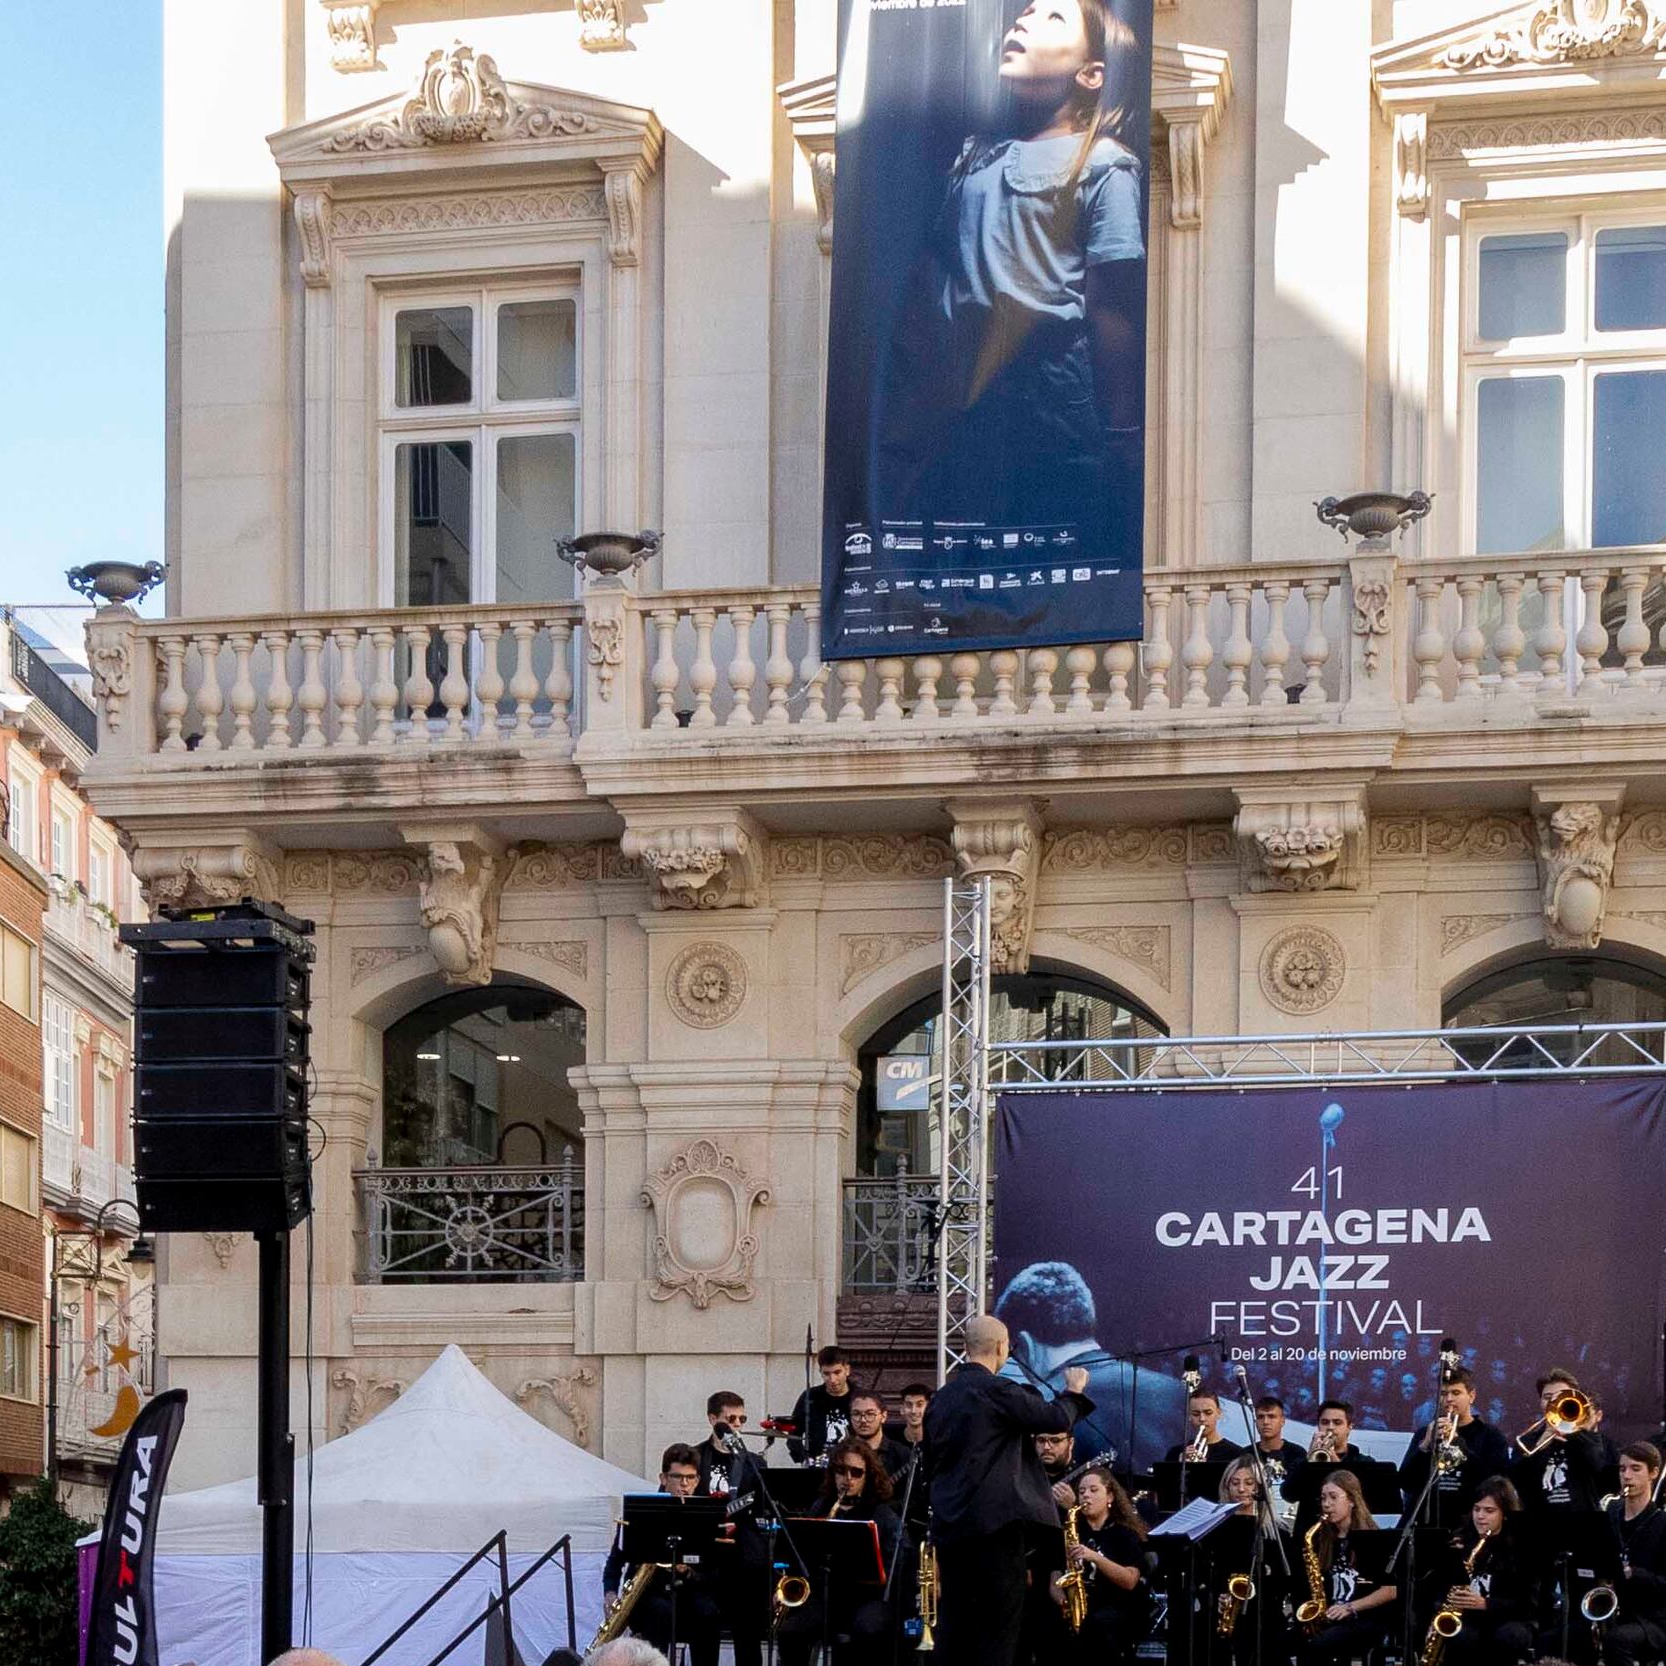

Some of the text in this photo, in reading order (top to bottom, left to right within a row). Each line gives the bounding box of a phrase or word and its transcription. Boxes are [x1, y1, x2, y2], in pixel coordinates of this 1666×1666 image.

[886, 1061, 923, 1079] CM
[1290, 1164, 1344, 1201] 41
[1155, 1207, 1492, 1248] CARTAGENA
[1249, 1254, 1390, 1292] JAZZ
[1209, 1299, 1444, 1337] FESTIVAL
[1230, 1346, 1407, 1361] Del 2 al 20 de noviembre
